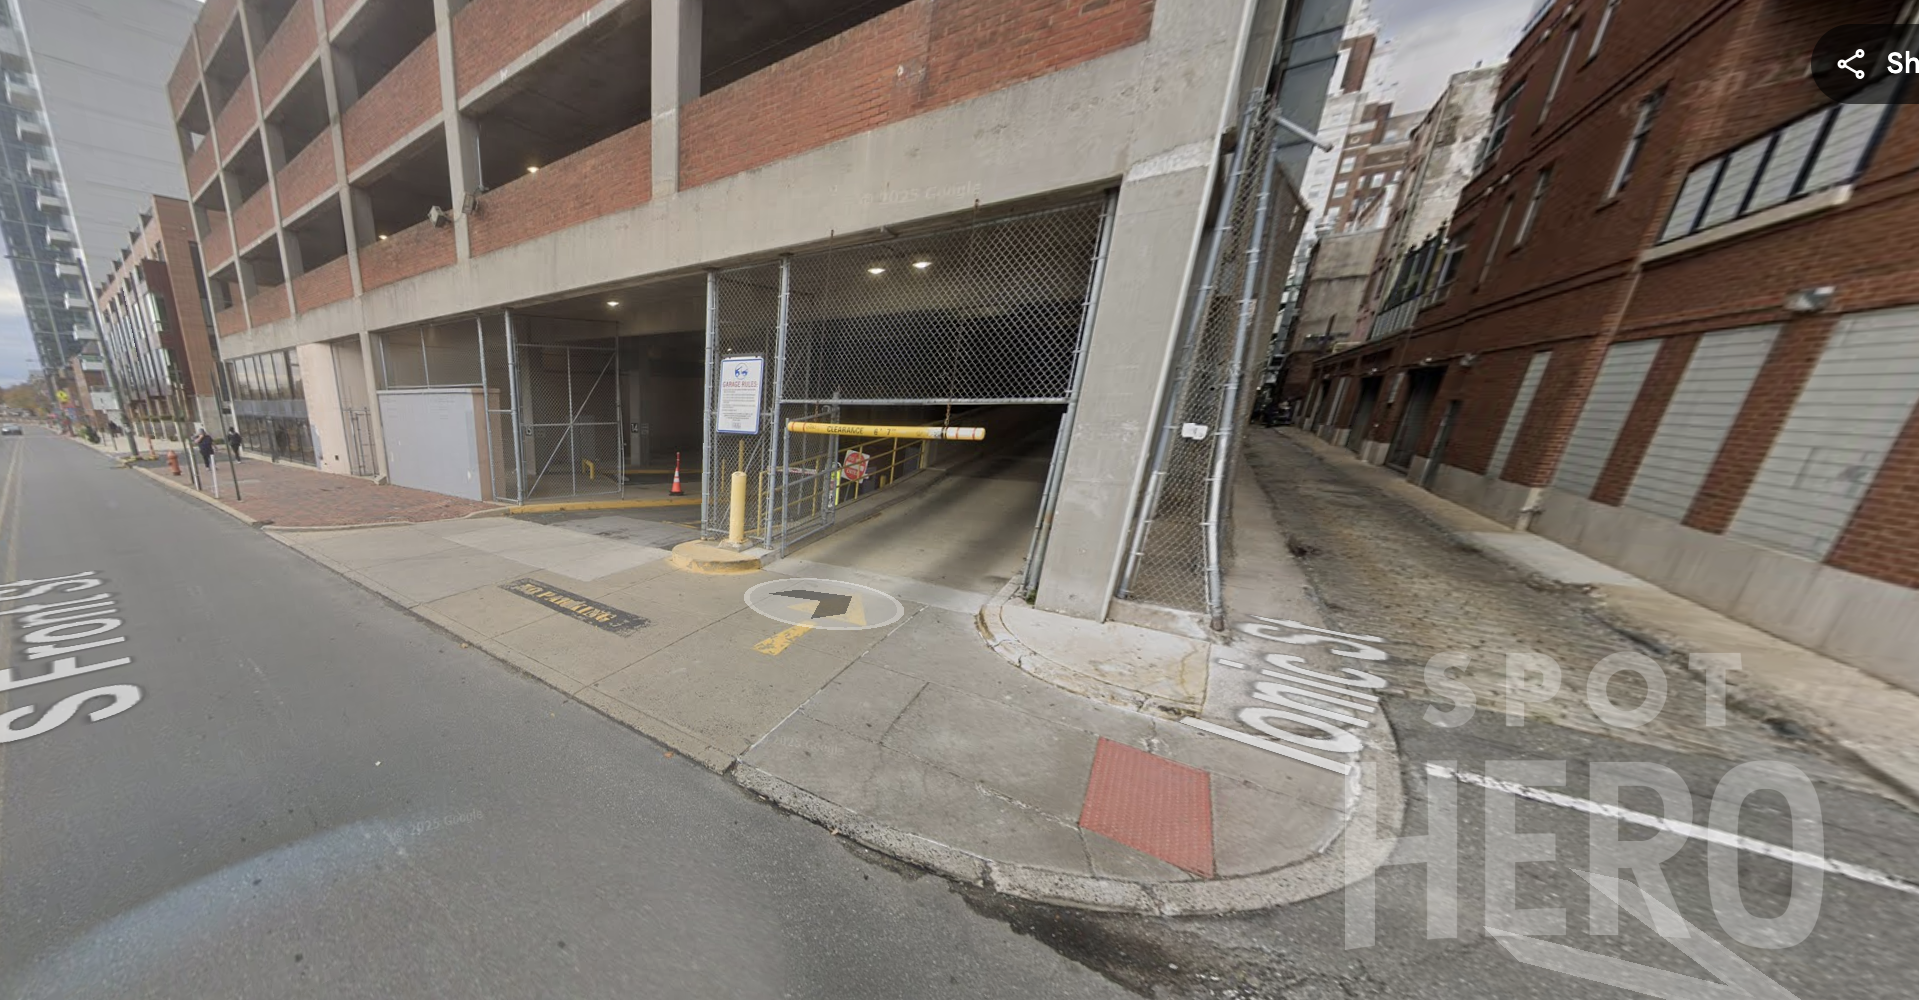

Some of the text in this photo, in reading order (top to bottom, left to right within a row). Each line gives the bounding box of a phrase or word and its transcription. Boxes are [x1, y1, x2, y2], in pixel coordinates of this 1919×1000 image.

[826, 426, 864, 436] CLEARANCE
[524, 583, 618, 623] NO PARKING
